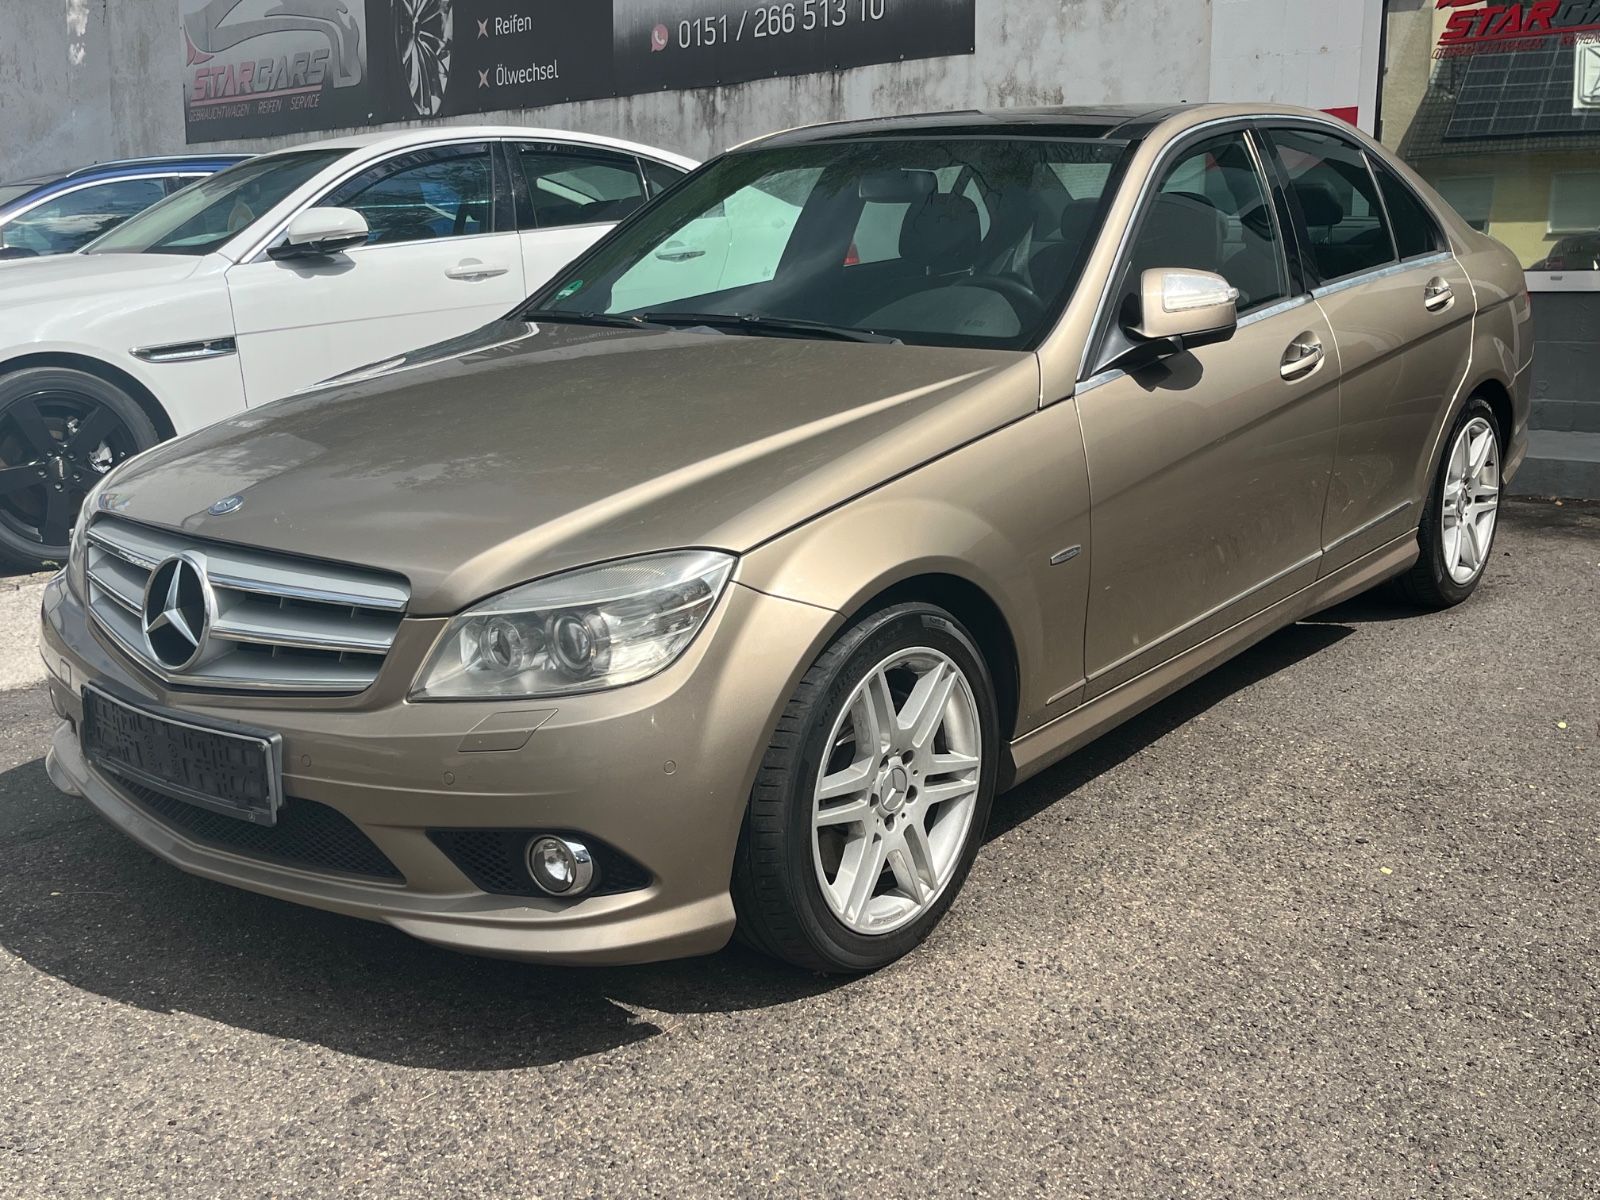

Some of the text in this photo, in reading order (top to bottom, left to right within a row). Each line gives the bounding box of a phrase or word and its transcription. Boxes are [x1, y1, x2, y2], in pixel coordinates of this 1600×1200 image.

[495, 13, 532, 36] Reifen
[678, 0, 885, 48] 0151 / 266 513 10
[190, 48, 330, 101] STARCARS
[496, 59, 559, 86] Ölwechsel
[188, 93, 320, 123] GEBRAUCHTWAGEN REIFEN SERVICE
